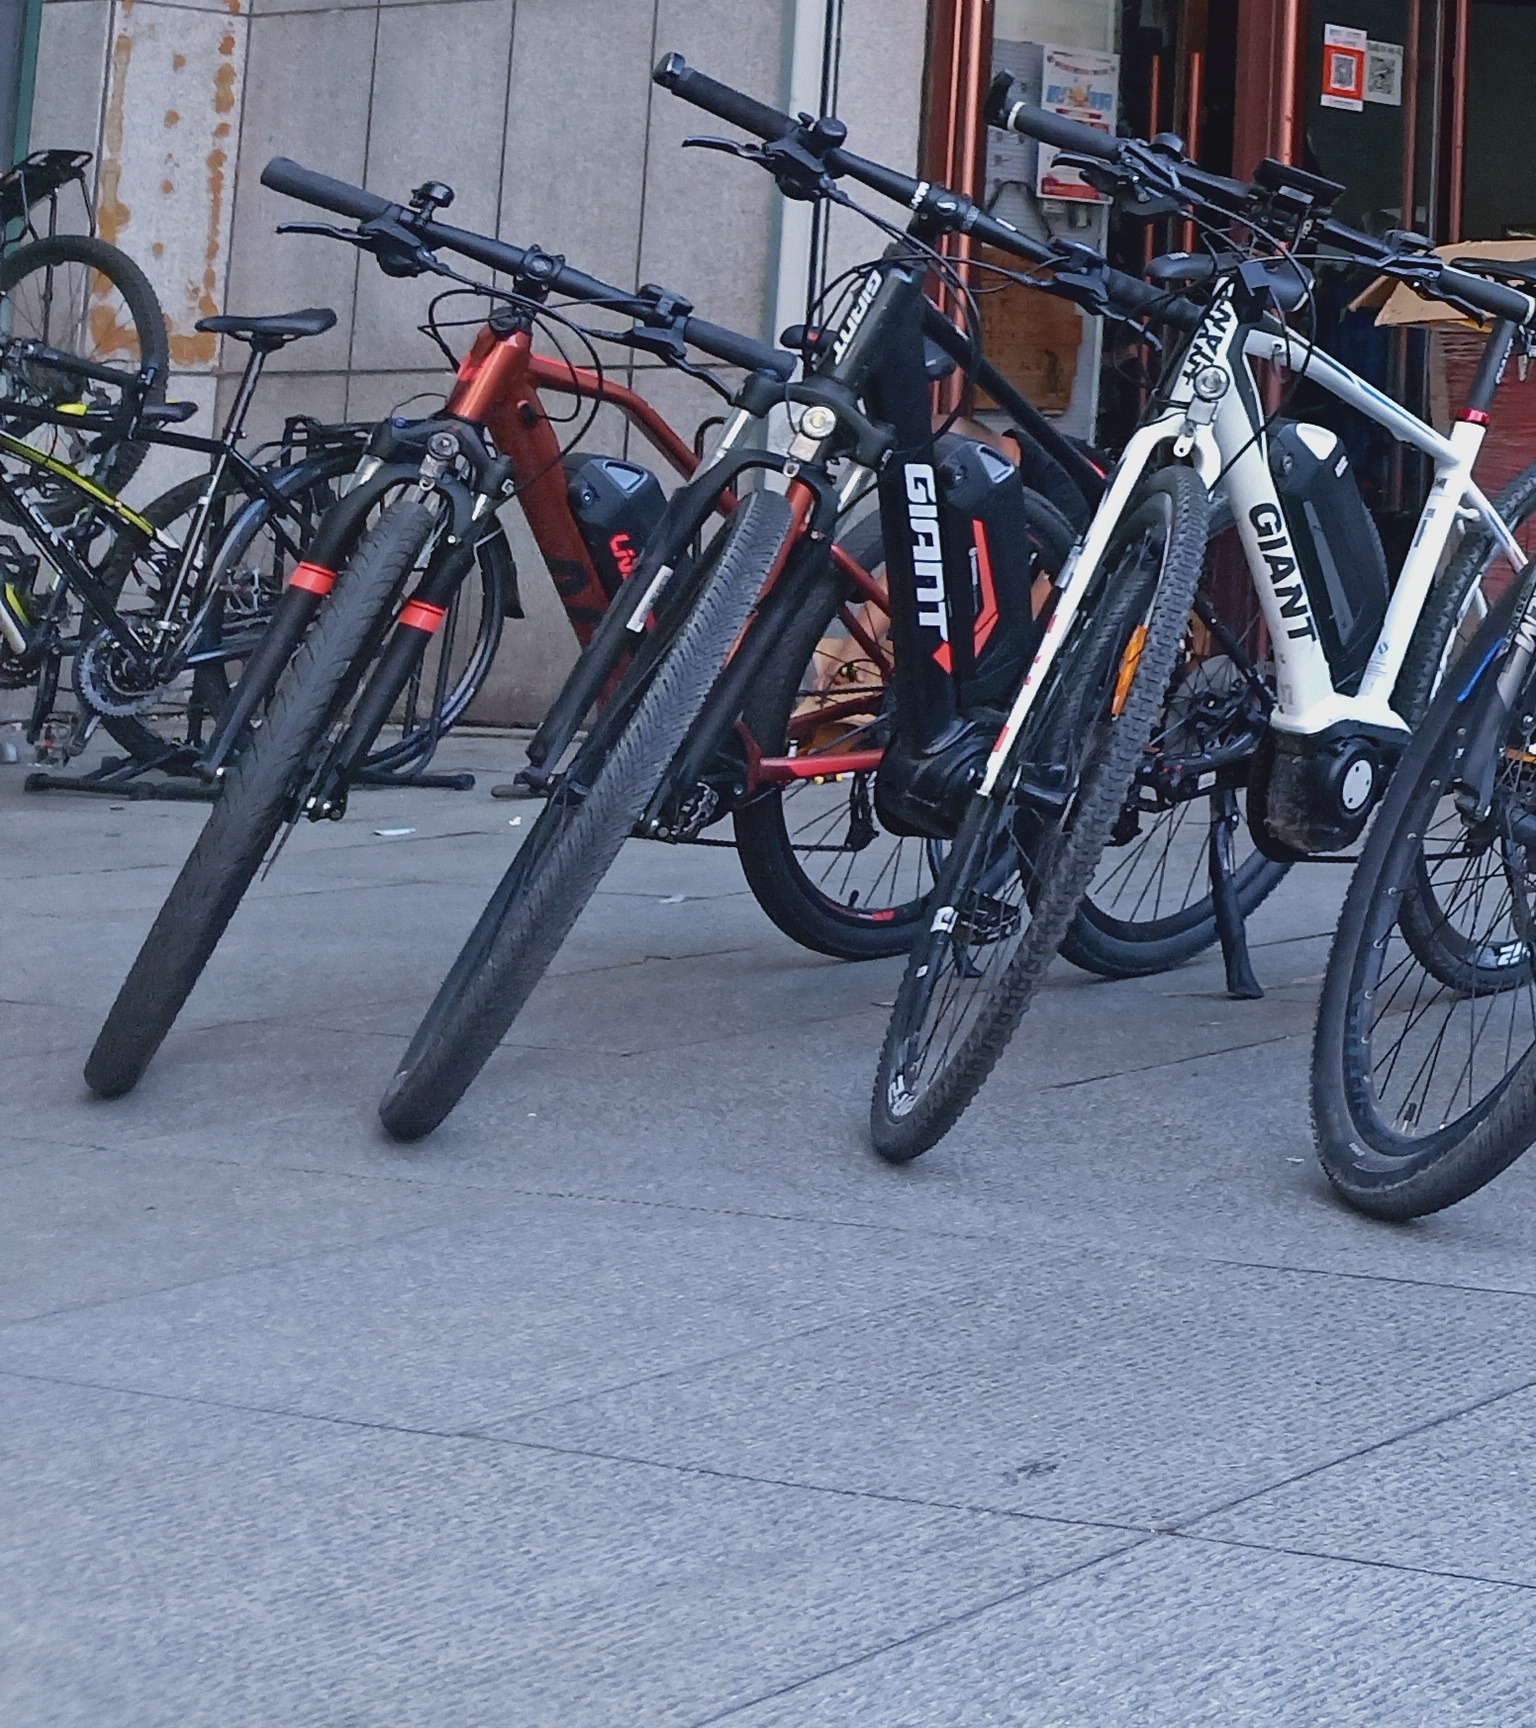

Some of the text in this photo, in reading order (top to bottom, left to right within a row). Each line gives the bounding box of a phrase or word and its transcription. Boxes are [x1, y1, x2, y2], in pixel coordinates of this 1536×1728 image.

[833, 269, 884, 365] GIANT
[904, 463, 949, 642] GIANT
[1249, 503, 1317, 643] GIANT
